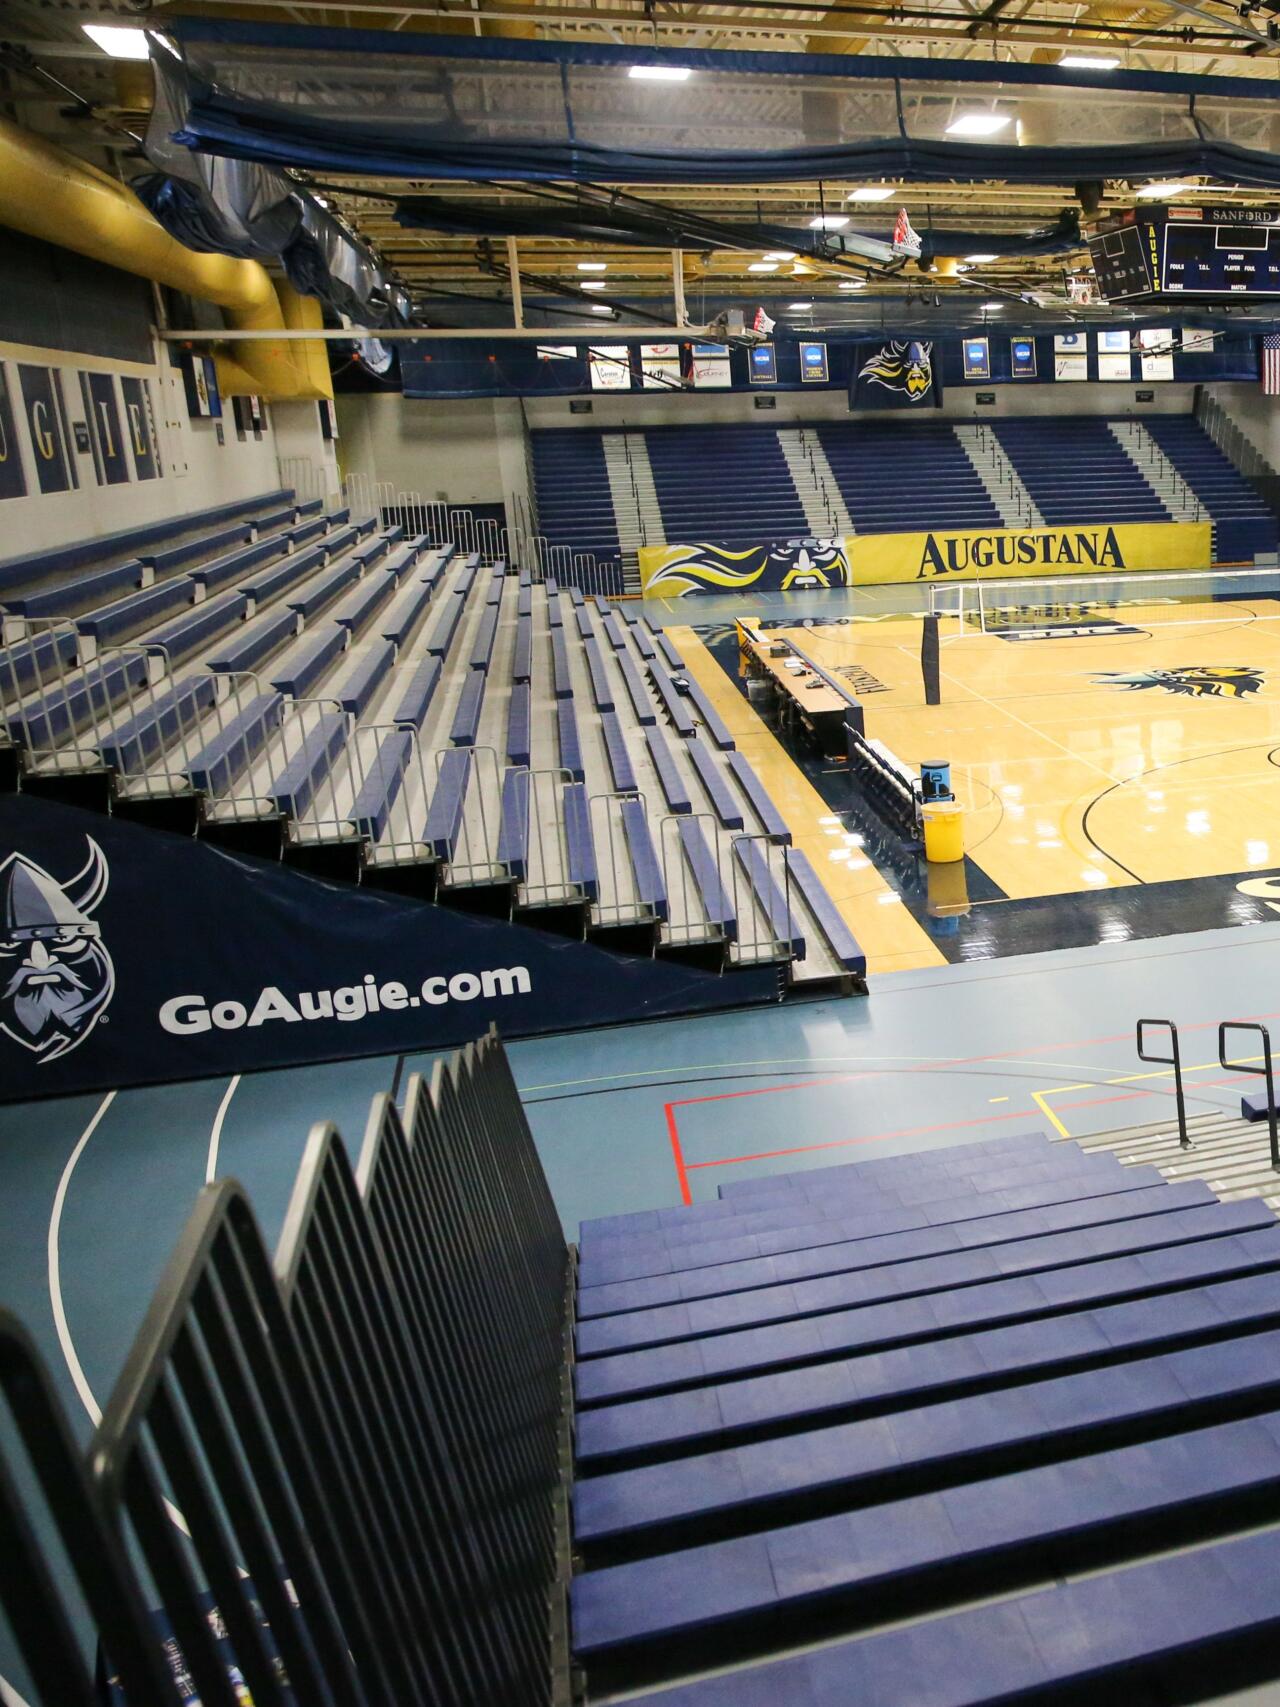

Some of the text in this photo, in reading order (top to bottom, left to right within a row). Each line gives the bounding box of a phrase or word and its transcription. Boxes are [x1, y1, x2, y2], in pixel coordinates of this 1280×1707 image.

[1213, 210, 1272, 222] SANFORD
[1149, 225, 1161, 292] AUGIE
[915, 527, 1126, 579] AUGUSTANA
[158, 964, 532, 1036] GoAugie.com
